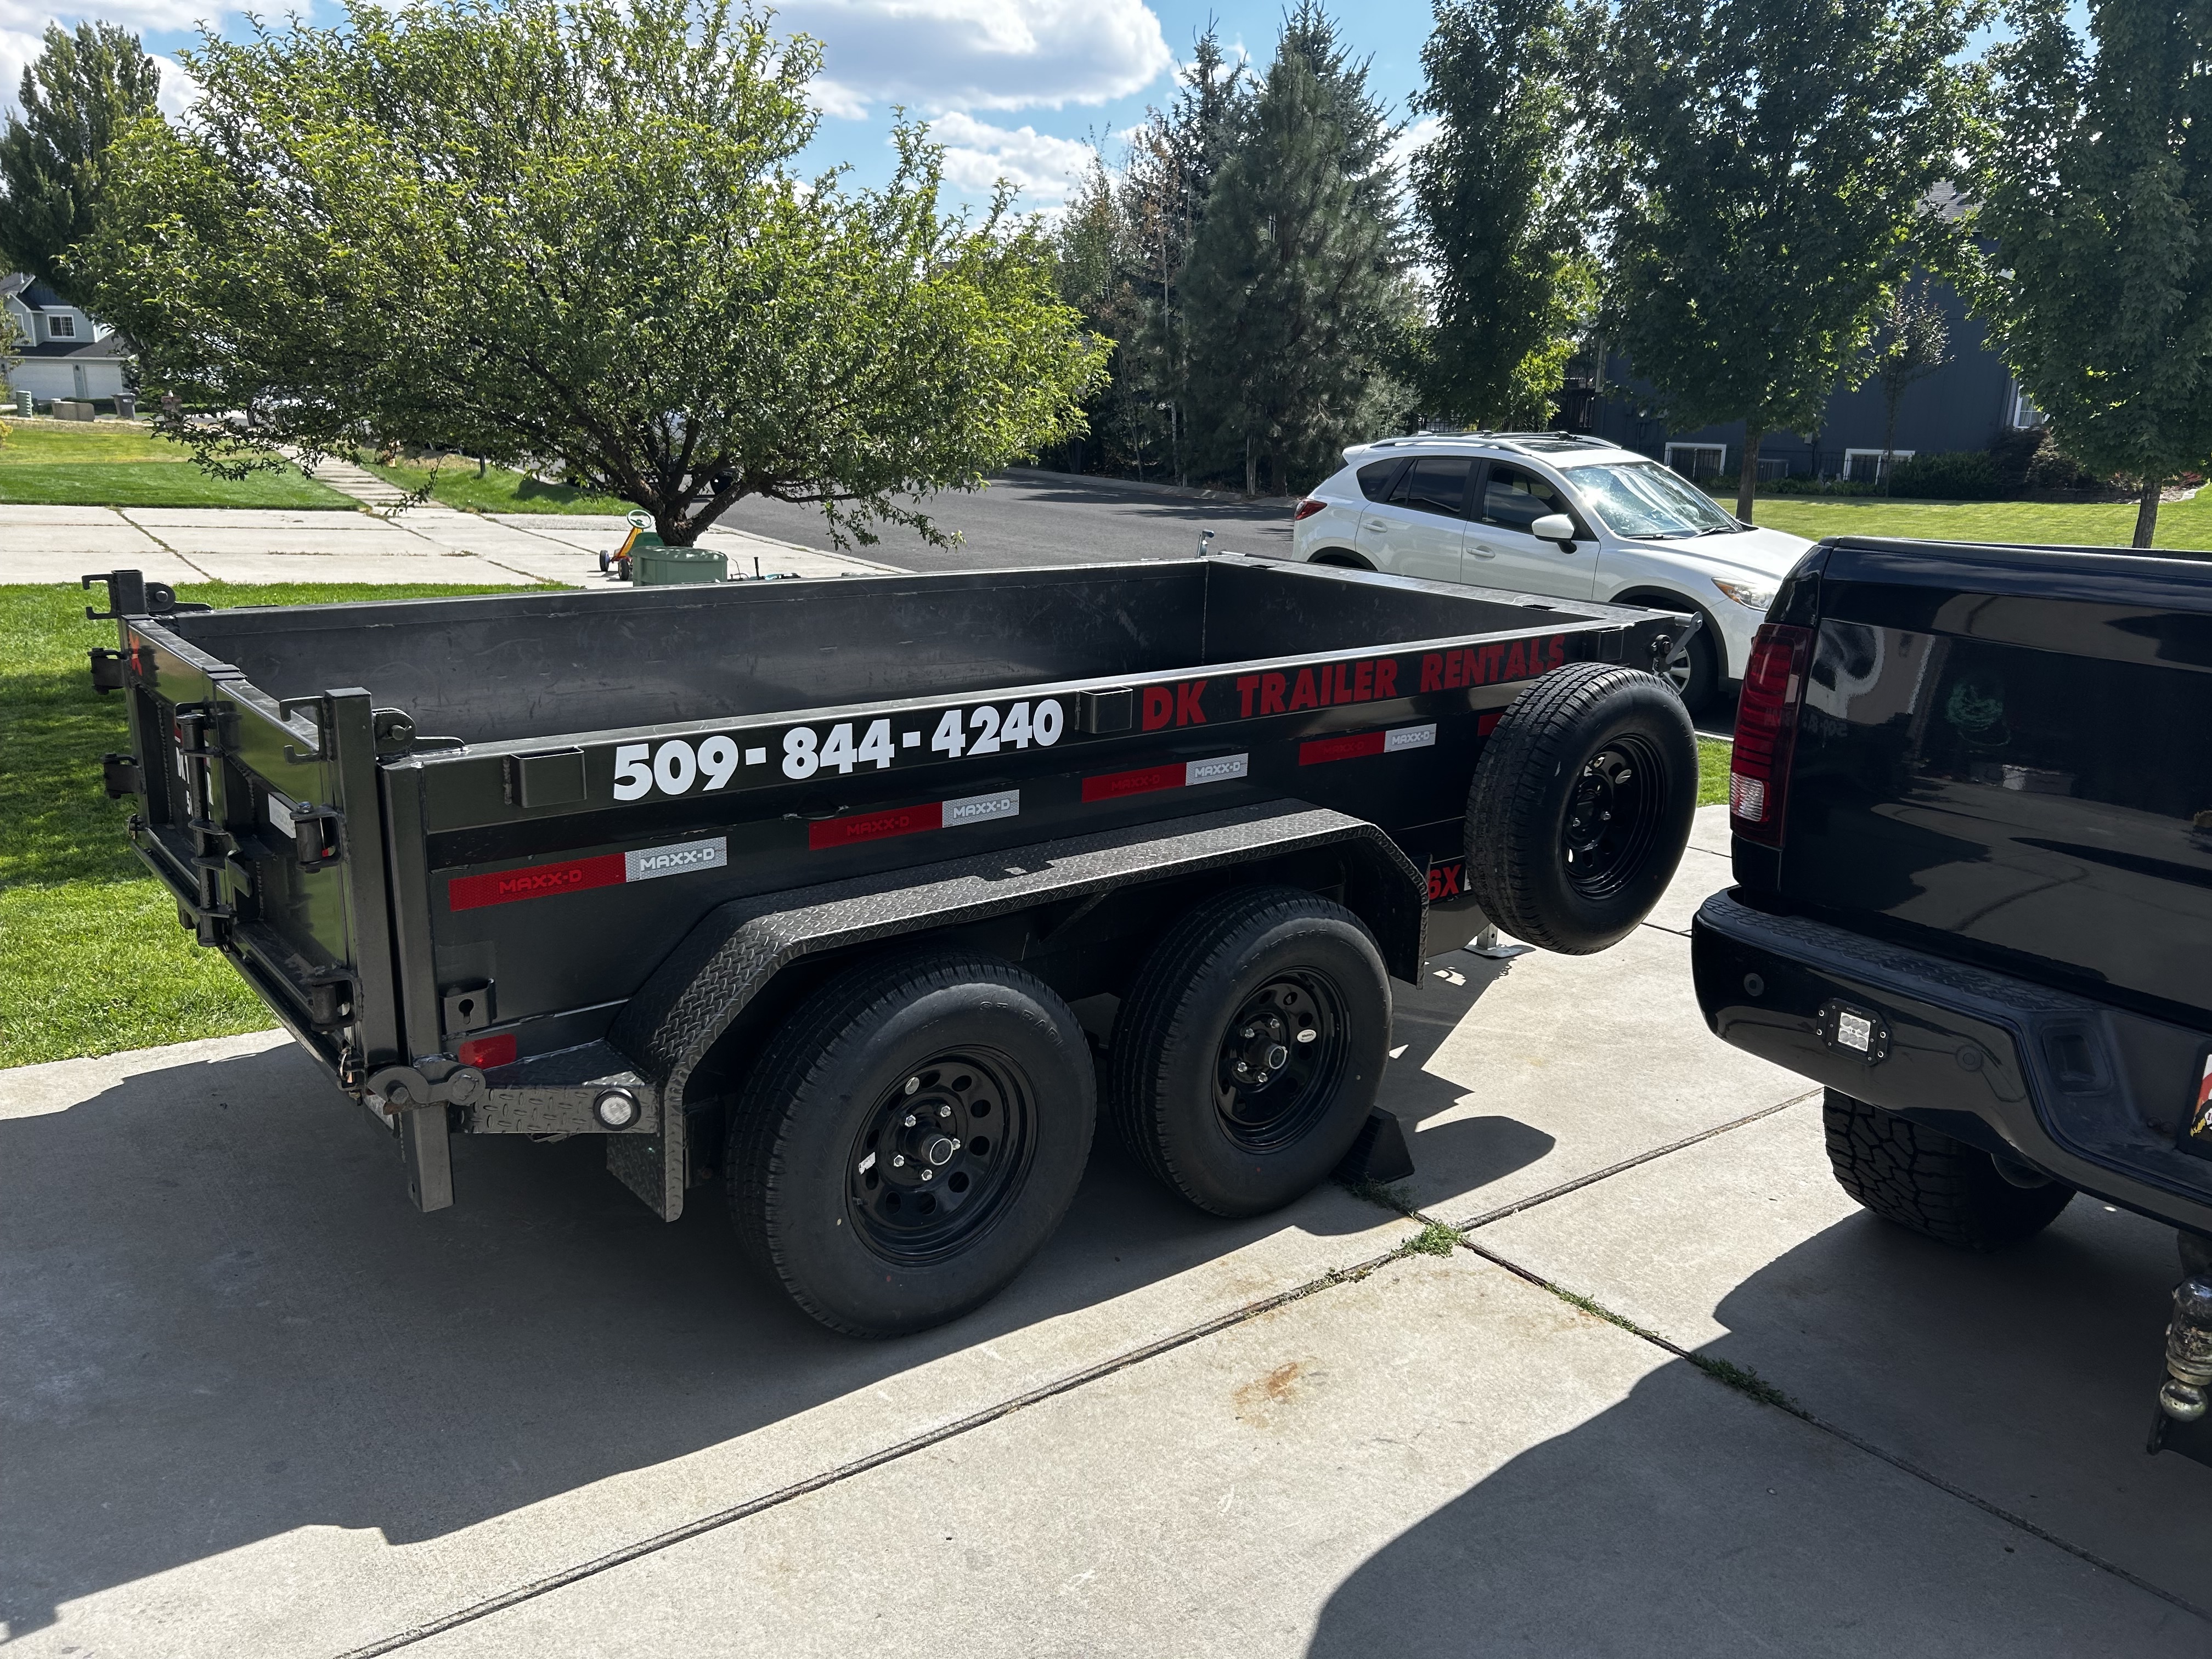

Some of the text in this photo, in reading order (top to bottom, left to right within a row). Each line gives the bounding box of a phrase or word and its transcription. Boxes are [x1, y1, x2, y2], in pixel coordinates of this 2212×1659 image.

[1142, 635, 1566, 731] DK TRAILER RENTALS
[1392, 731, 1430, 745] MAXX-D
[1195, 761, 1240, 777] MAXX-D
[1111, 774, 1160, 791] MAXX-D
[953, 799, 1010, 819] MAXX-D
[847, 816, 910, 836] MAXX-D
[640, 848, 715, 871] MAXX-D
[499, 870, 582, 894] MAXX-D
